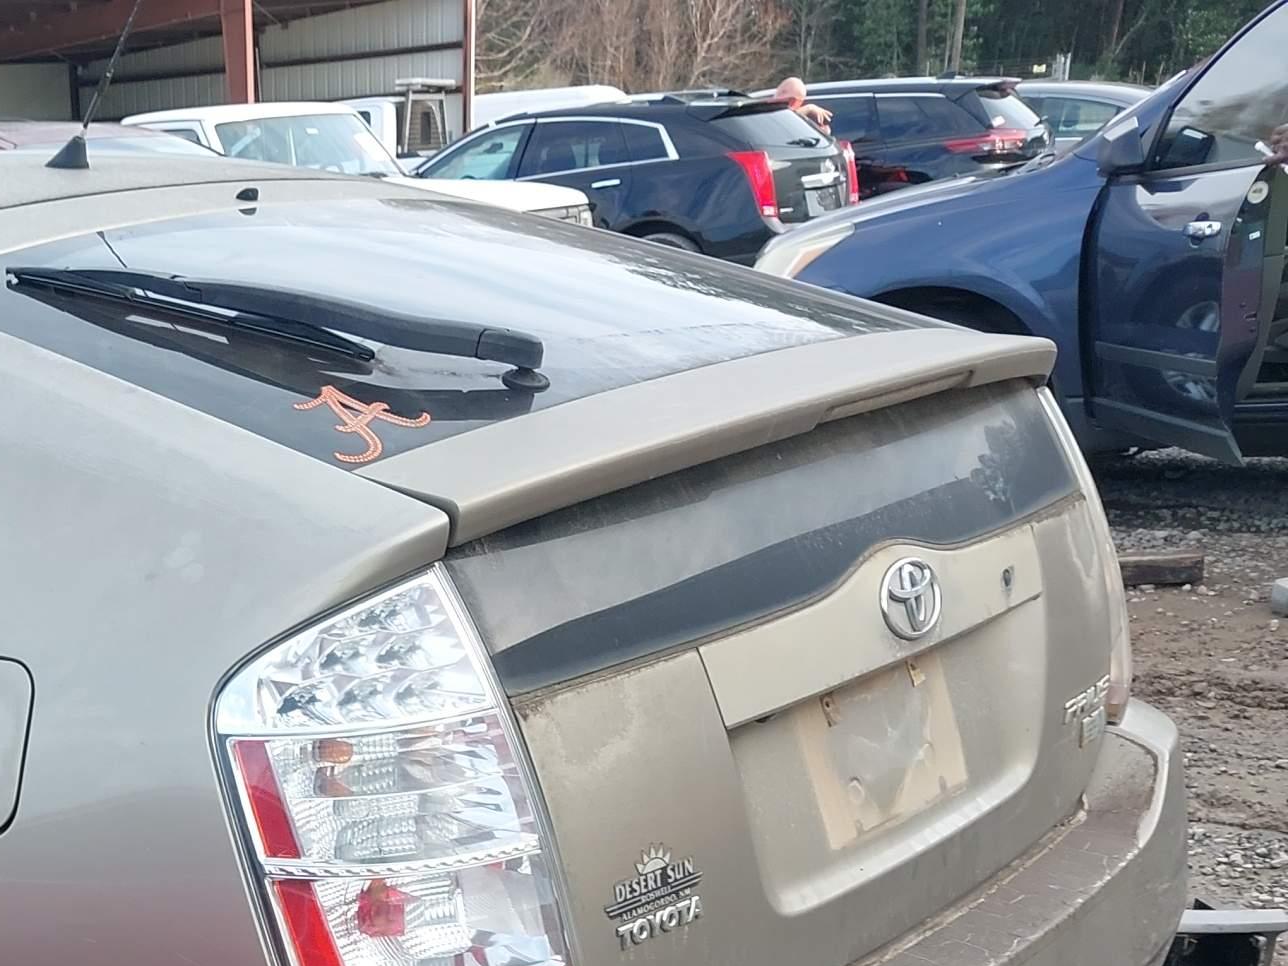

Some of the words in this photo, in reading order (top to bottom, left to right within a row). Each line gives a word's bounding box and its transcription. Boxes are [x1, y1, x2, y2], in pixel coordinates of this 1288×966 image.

[615, 870, 662, 902] DESERT
[666, 857, 694, 883] SUN
[639, 885, 673, 903] ROSWELL
[616, 895, 704, 951] TOYOTA
